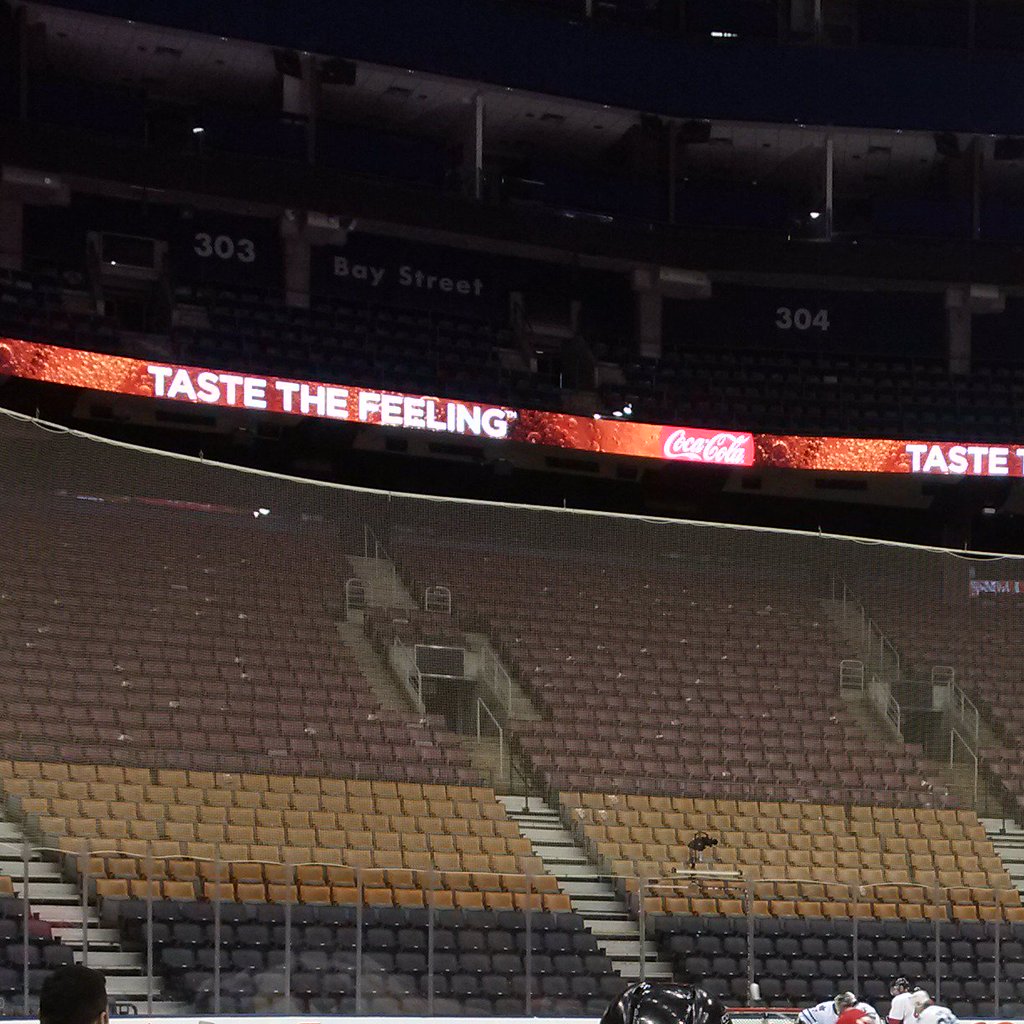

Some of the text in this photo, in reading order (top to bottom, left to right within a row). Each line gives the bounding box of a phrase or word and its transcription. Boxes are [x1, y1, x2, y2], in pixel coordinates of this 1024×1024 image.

[193, 233, 256, 263] 303
[333, 255, 484, 296] Bay Street
[775, 306, 831, 332] 304
[147, 365, 267, 409] TASTE
[276, 381, 348, 419] THE
[906, 444, 1009, 475] TASTE
